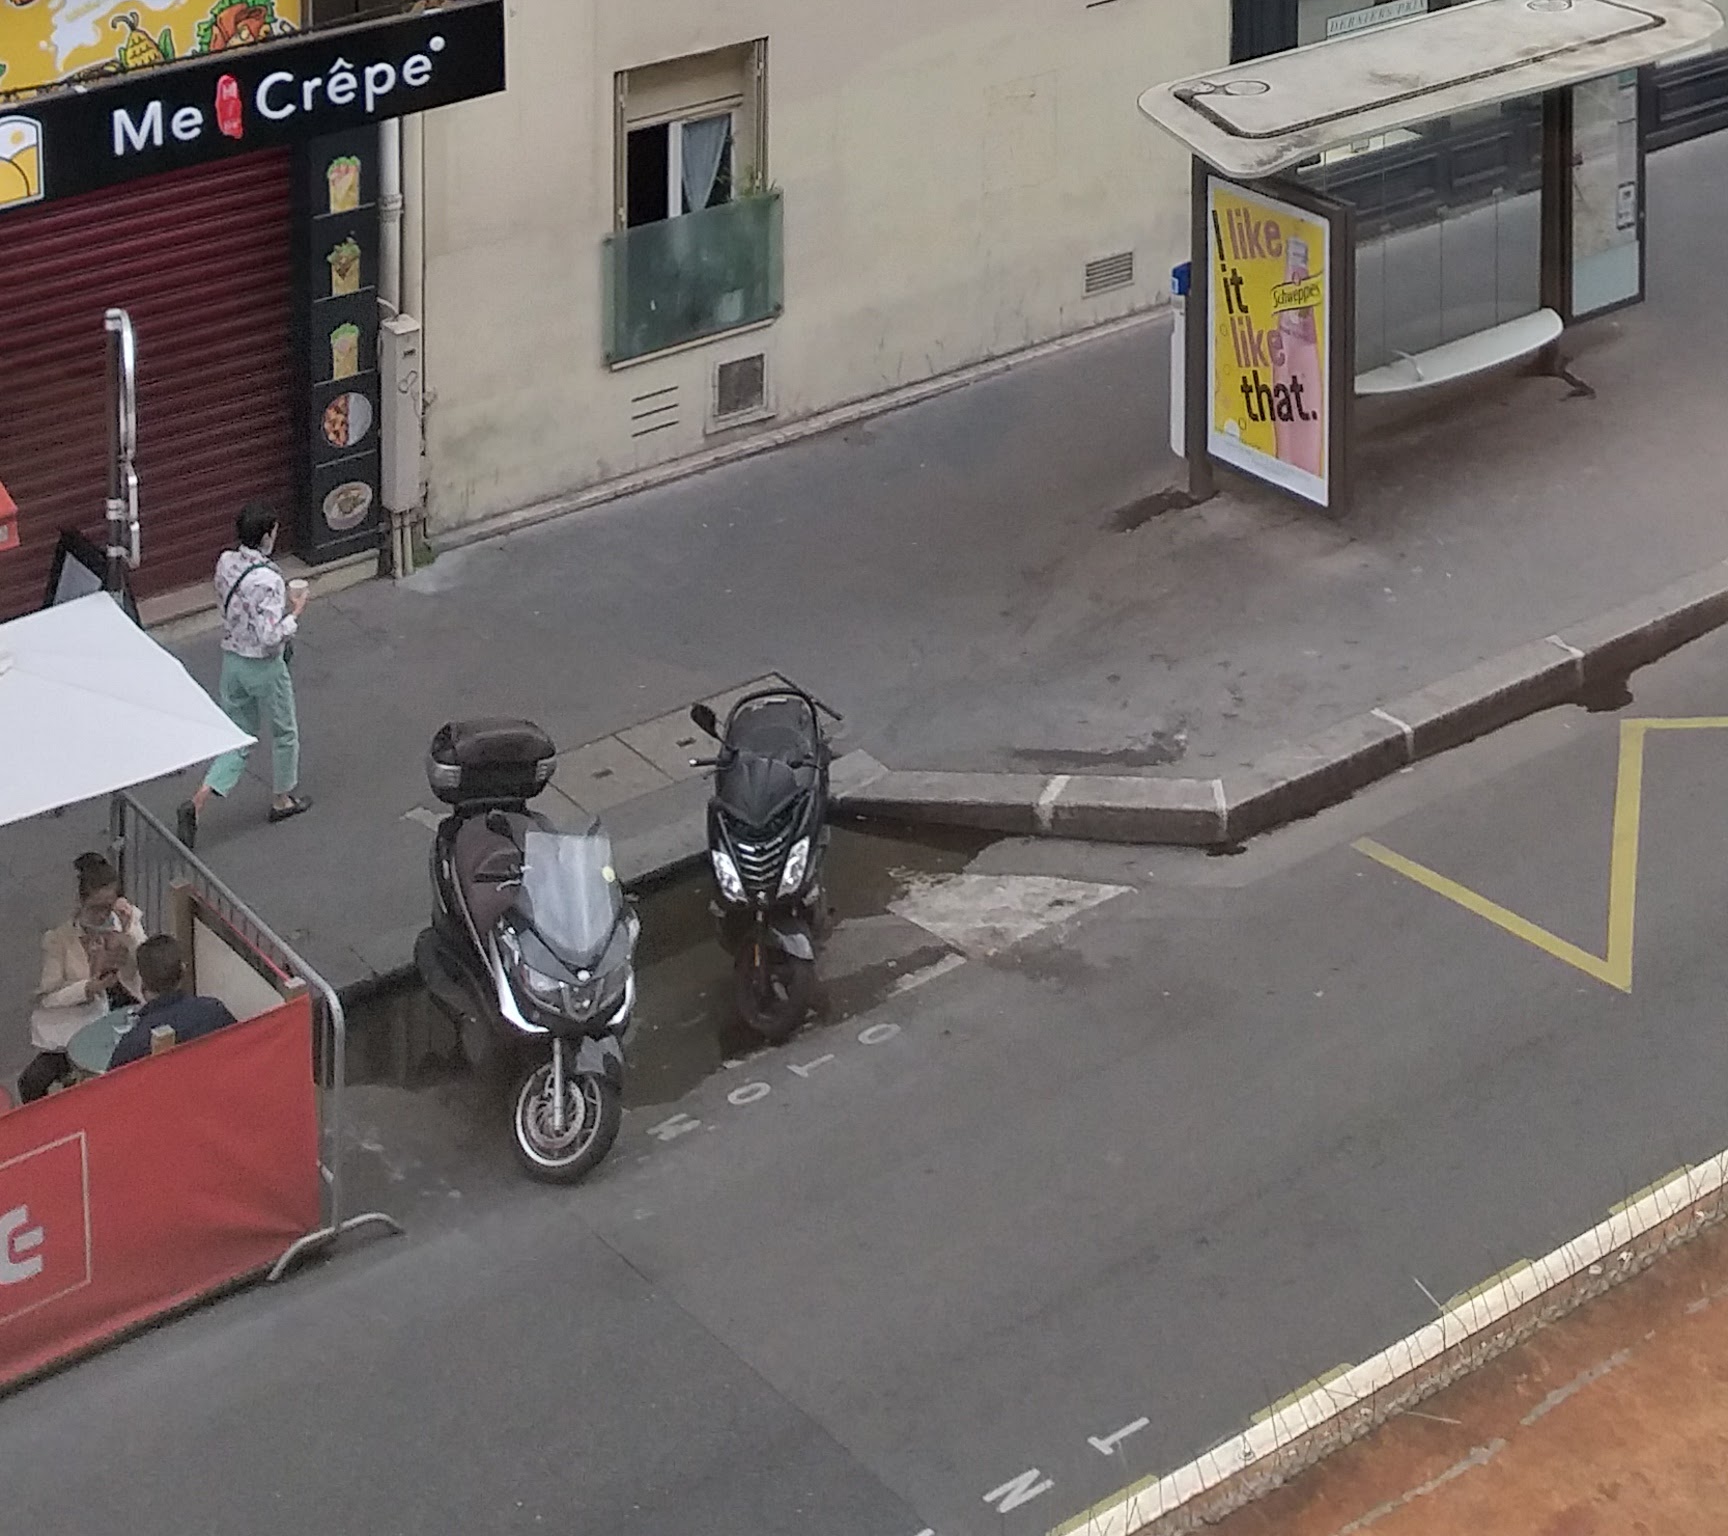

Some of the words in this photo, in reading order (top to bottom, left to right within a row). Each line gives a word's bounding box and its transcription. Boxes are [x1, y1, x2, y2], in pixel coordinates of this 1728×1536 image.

[111, 100, 204, 156] Me
[255, 54, 434, 120] Crêpe
[1226, 208, 1284, 260] like
[1220, 263, 1249, 315] it
[1272, 283, 1321, 310] Schweppes
[1229, 315, 1287, 369] like
[1240, 370, 1319, 423] that.
